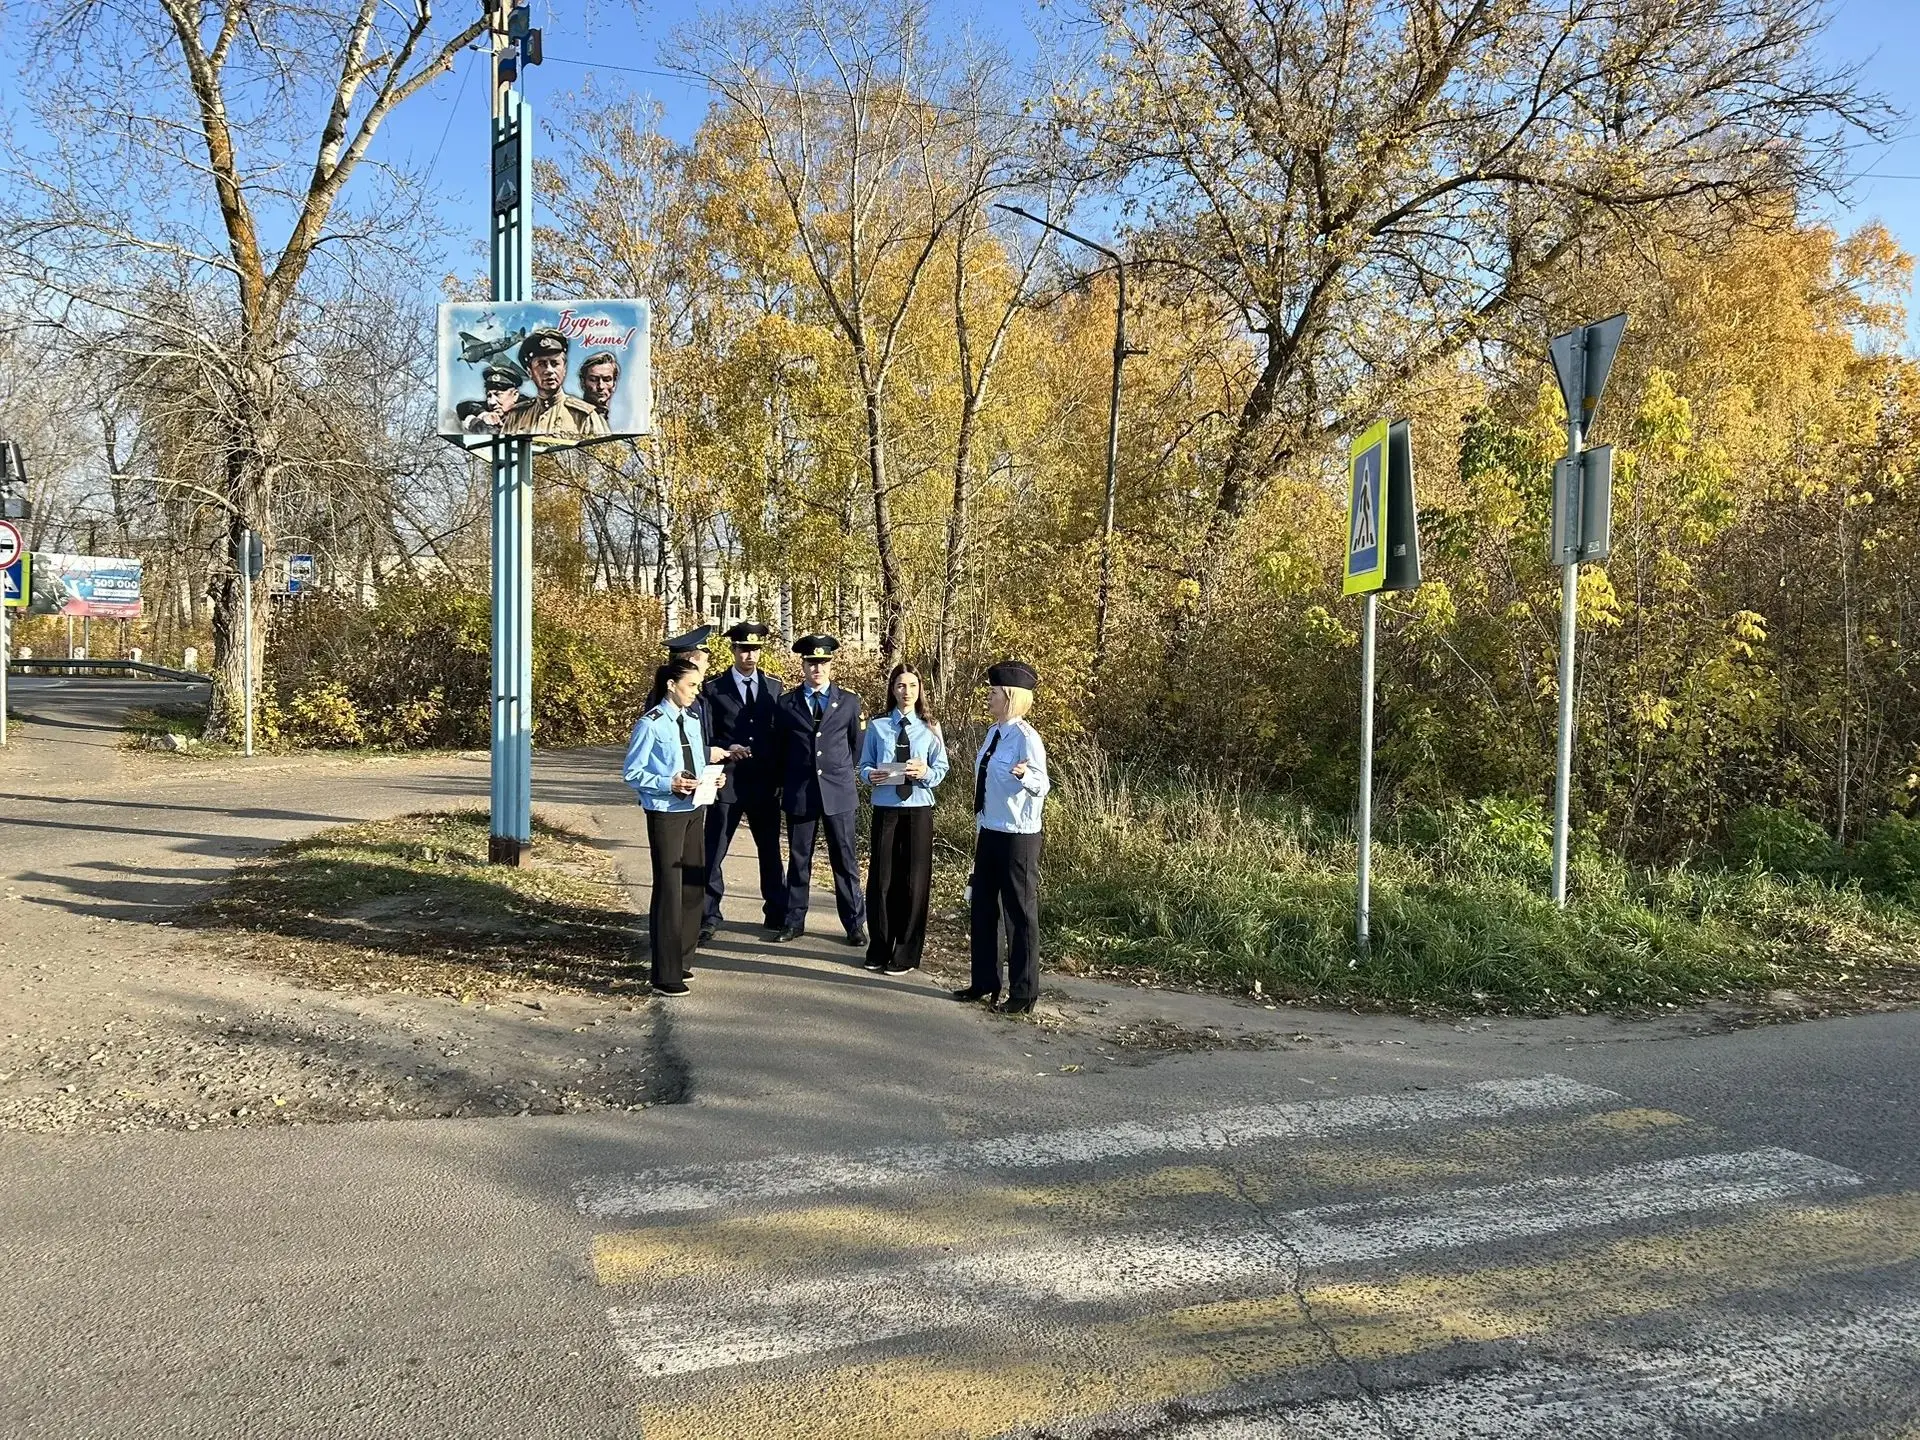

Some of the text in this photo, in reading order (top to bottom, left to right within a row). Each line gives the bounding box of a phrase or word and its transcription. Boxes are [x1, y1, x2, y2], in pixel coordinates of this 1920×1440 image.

[559, 310, 611, 338] Будем
[580, 328, 636, 350] жить!
[116, 580, 138, 589] 000
